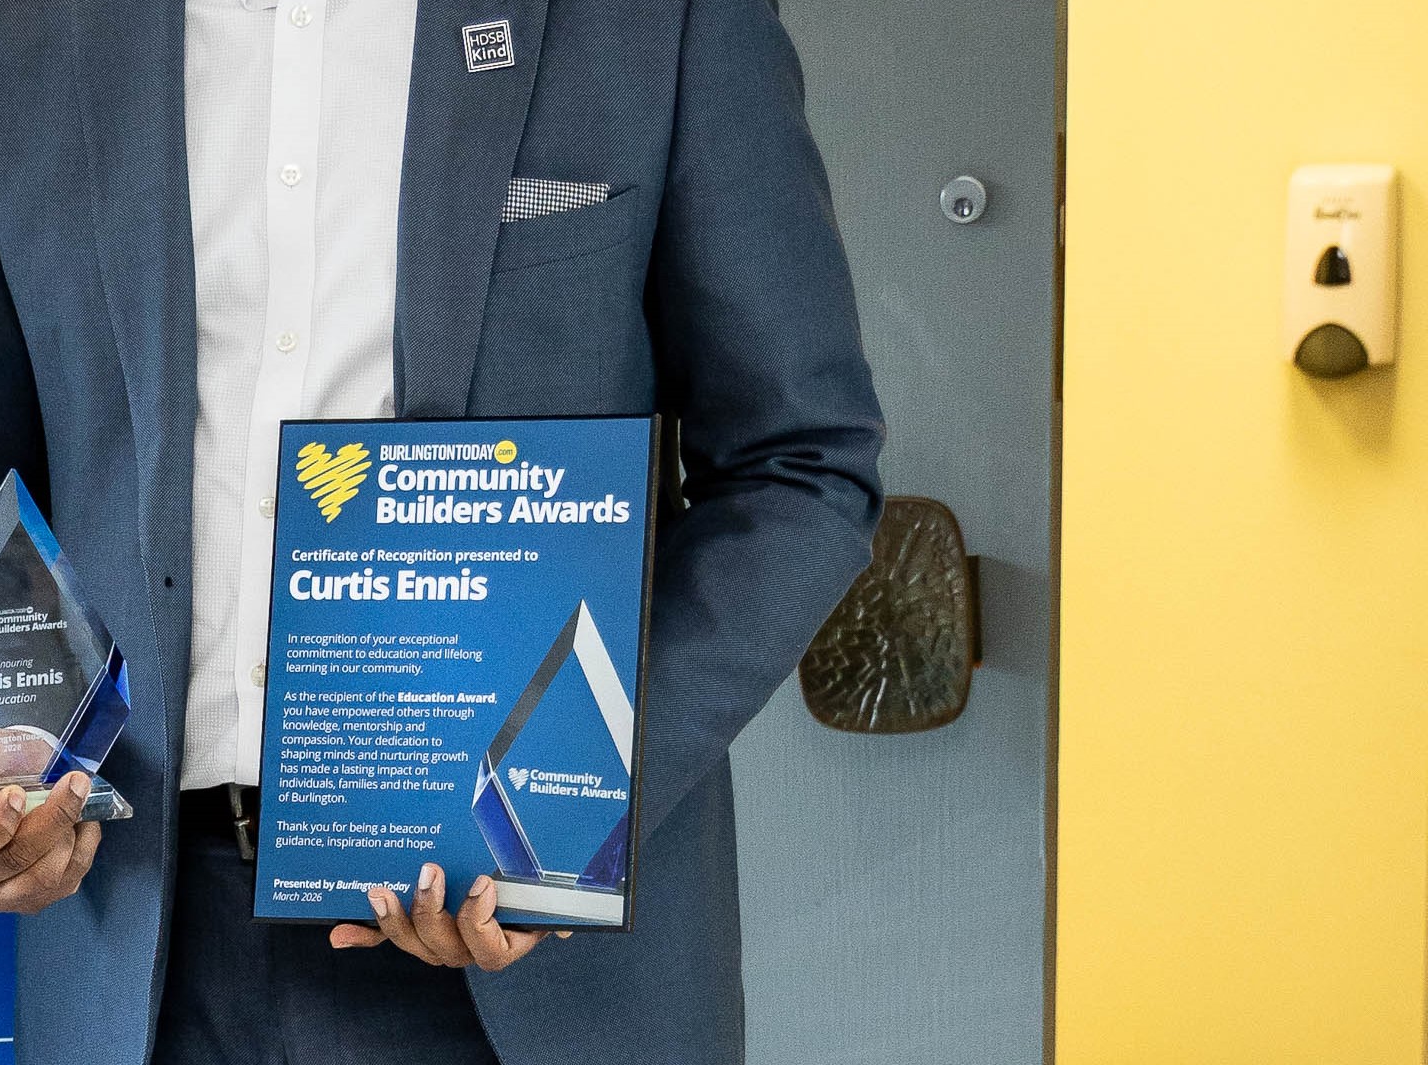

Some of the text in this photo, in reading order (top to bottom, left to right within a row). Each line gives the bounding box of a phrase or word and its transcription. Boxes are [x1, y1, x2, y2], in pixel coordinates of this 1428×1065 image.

[470, 31, 505, 47] HDSB
[472, 44, 507, 62] Kind
[380, 444, 496, 461] BURLINGTONTODAY
[377, 462, 565, 498] Community
[375, 494, 629, 525] Builders Awards
[292, 549, 538, 565] Certificate of Recognition presented to
[289, 568, 487, 601] Curtis Ennis
[32, 620, 67, 631] Awards
[288, 634, 458, 647] In recognition of your exceptional
[287, 649, 482, 662] commitment to education and lifelong
[286, 662, 423, 675] learning in our community.
[17, 669, 63, 687] Ennis
[284, 692, 497, 705] As the recipient of the Education Award,
[283, 706, 475, 720] you have empowered others through
[283, 720, 425, 733] knowledge, mentorship and
[282, 736, 442, 747] compassion. Your dedication to
[281, 749, 468, 763] shaping minds and nurturing growth
[280, 763, 298, 773] has
[301, 764, 330, 774] made
[342, 764, 374, 777] lasting
[377, 765, 412, 777] impact
[415, 767, 428, 775] on
[279, 778, 454, 791] individuals, families and the future
[530, 769, 602, 788] Community
[529, 782, 627, 800] Builders Awards
[279, 792, 347, 805] of Burlington.
[277, 821, 441, 835] Thank you for being a beacon of
[276, 836, 436, 850] guidance, inspiration and hope.
[274, 878, 321, 889] Presented
[322, 879, 335, 892] by
[272, 892, 323, 902] March 2026
